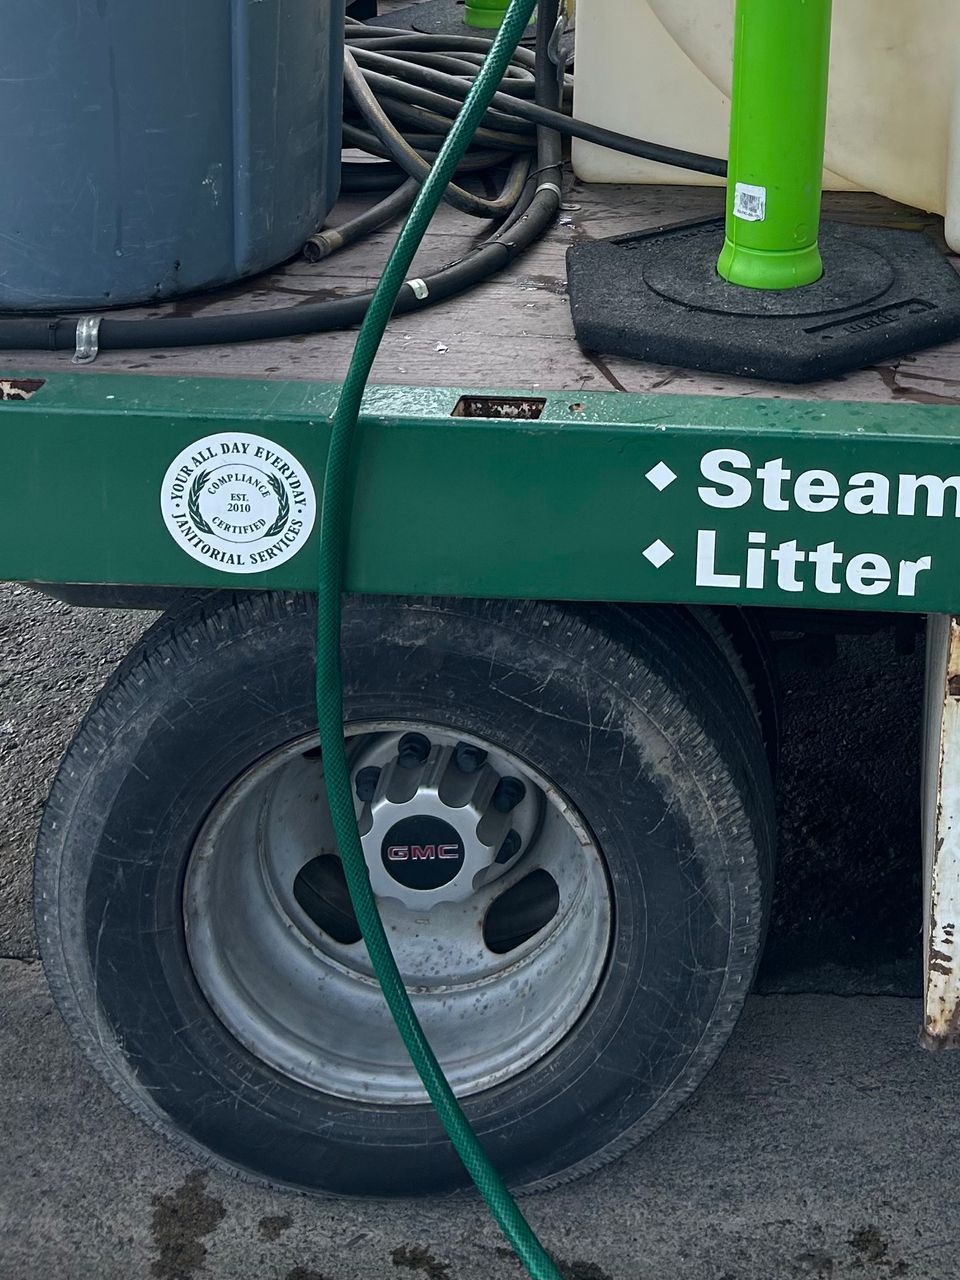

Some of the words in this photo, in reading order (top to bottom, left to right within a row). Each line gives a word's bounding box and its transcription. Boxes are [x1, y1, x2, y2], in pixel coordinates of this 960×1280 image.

[171, 465, 193, 500] YOUR
[192, 447, 218, 467] ALL
[221, 442, 250, 455] DAY
[254, 446, 307, 507] EVERYDAY
[207, 473, 271, 498] COMPLIANCE
[227, 503, 251, 513] 2010
[230, 493, 249, 502] EST.
[211, 516, 266, 534] CERTIFIED
[171, 512, 245, 565] JANITORIAL
[249, 518, 304, 565] SERVICES
[695, 529, 932, 600] Litter
[387, 843, 459, 861] GMC
